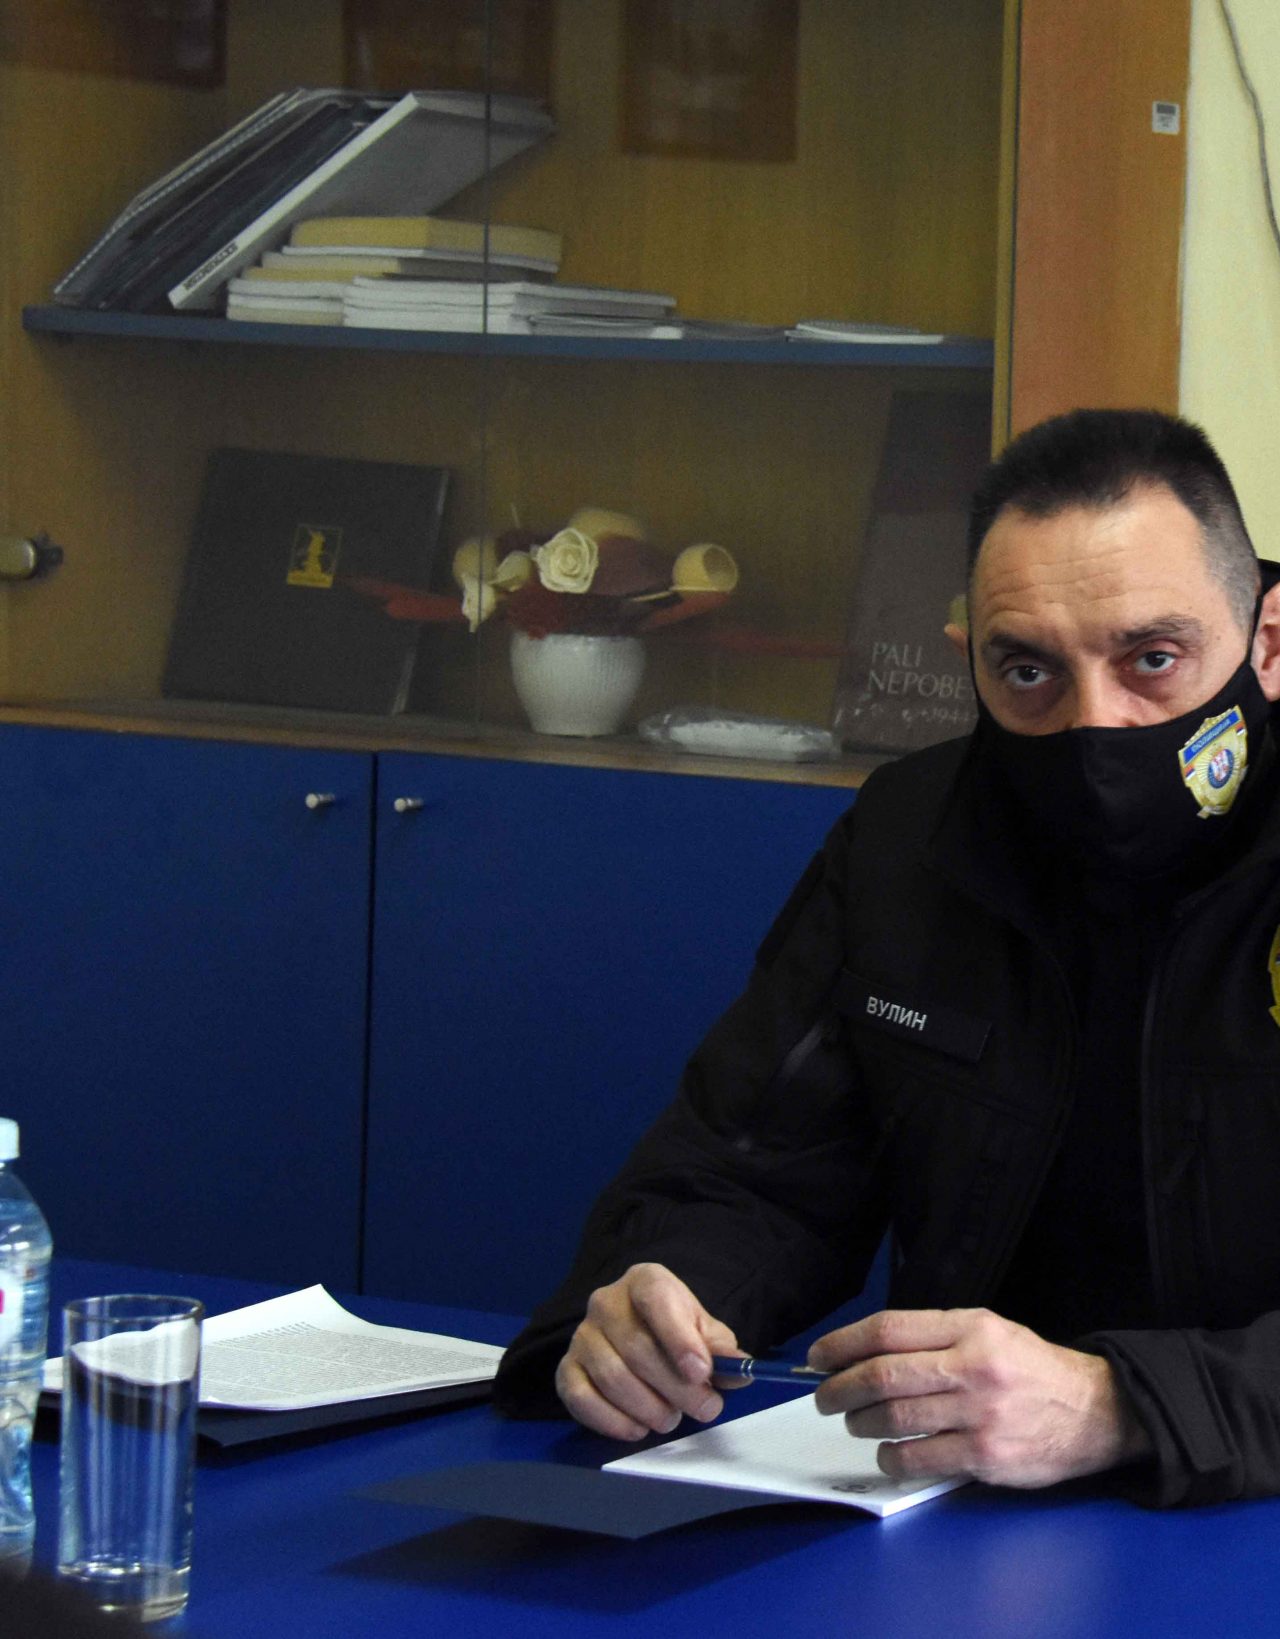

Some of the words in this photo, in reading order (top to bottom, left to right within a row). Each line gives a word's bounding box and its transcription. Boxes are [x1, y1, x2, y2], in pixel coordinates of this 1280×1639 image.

[871, 642, 922, 667] PALI
[866, 670, 975, 700] NEPOBE
[866, 996, 928, 1031] ВУЛИН
